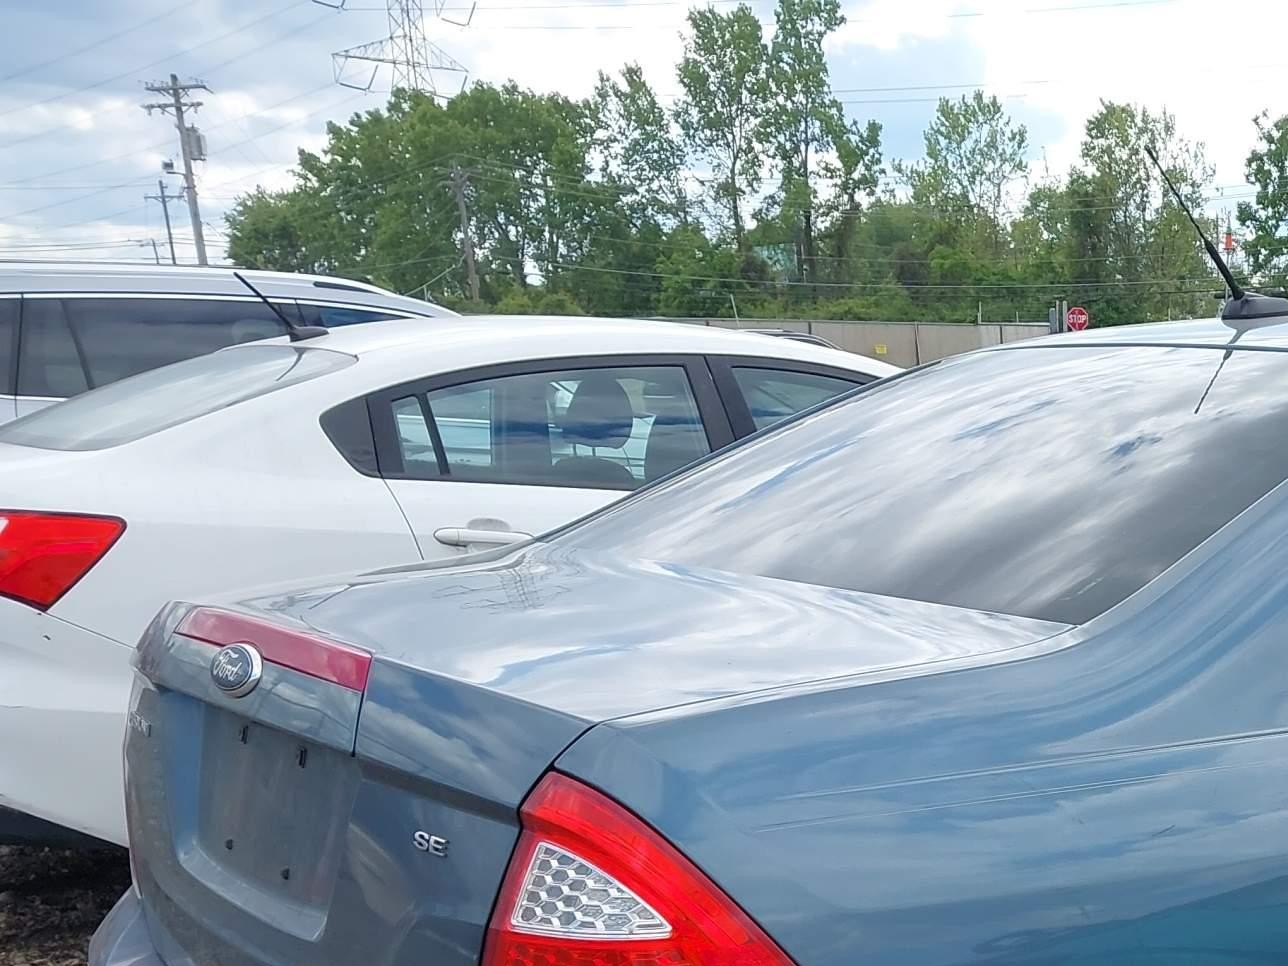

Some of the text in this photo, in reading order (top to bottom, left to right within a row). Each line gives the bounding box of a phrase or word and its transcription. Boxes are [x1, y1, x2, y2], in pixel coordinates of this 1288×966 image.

[1068, 314, 1087, 323] STOP
[213, 649, 243, 681] Ford
[413, 831, 448, 857] SE
